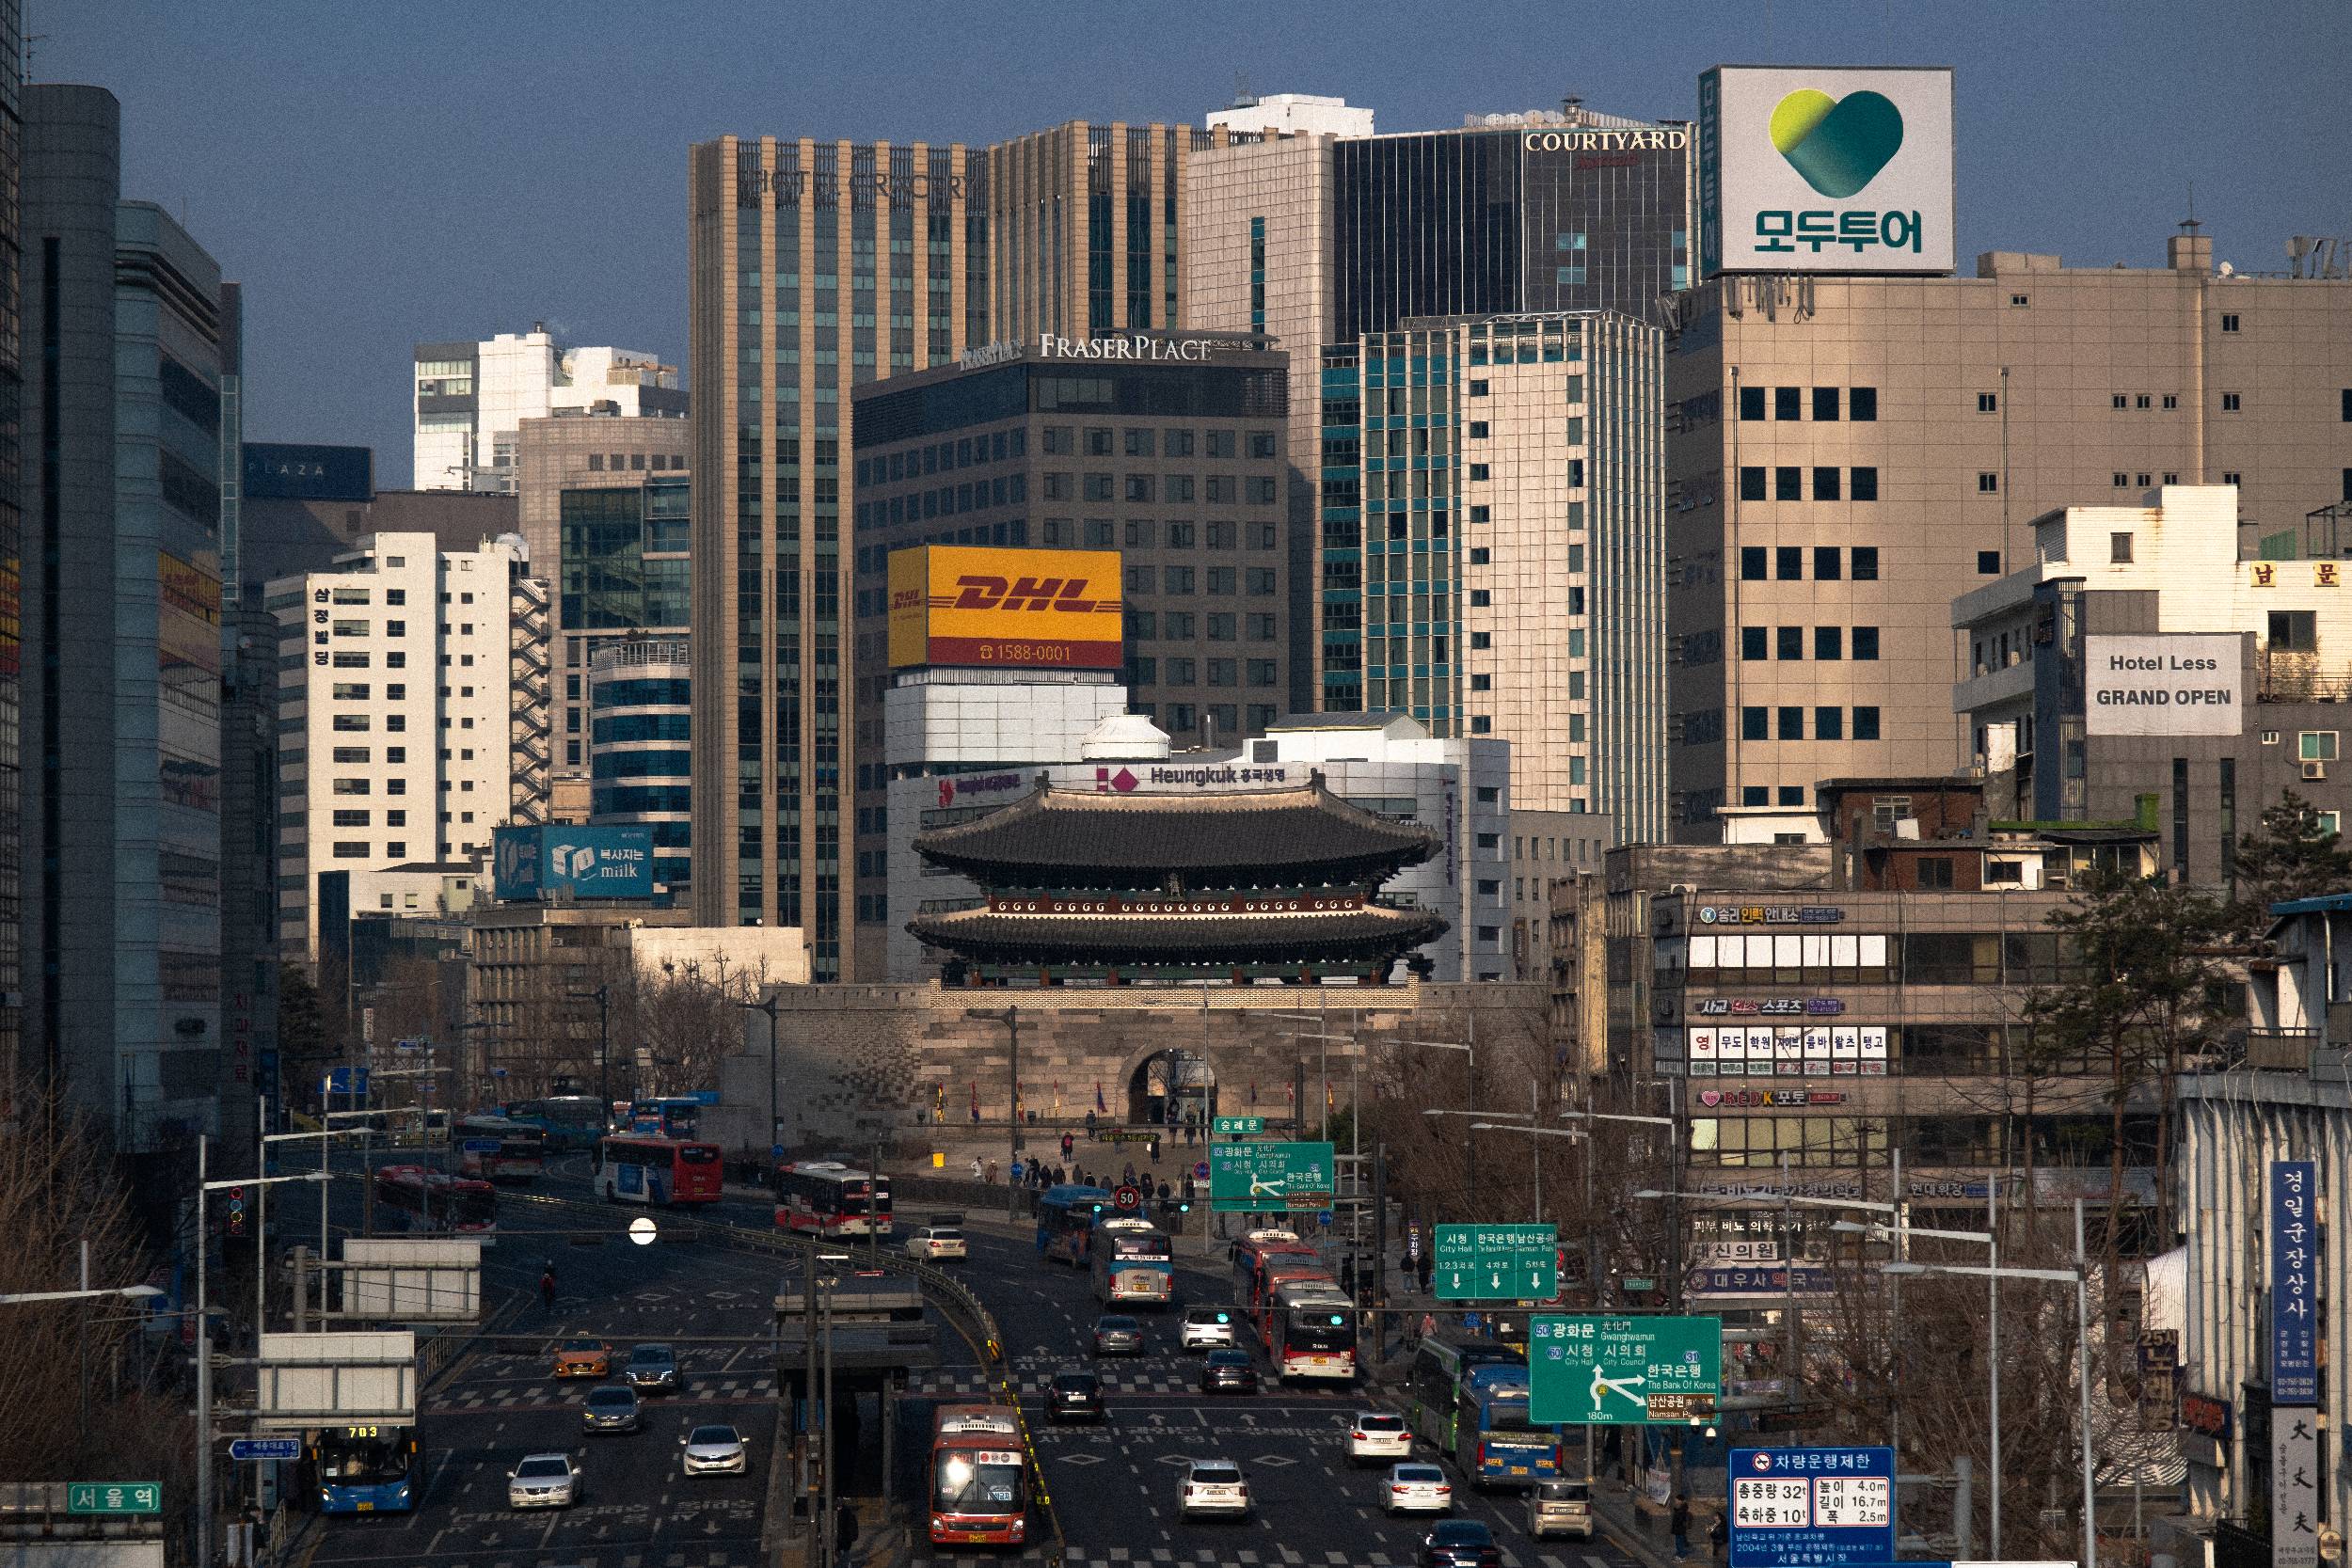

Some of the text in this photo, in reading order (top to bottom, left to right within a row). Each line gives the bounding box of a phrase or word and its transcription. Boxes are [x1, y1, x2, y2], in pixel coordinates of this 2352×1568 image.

[1525, 131, 1685, 151] COURTYARD
[1755, 211, 1921, 253] 모두투어
[248, 463, 324, 476] PLAZA
[893, 589, 920, 610] DHL
[954, 575, 1097, 612] DHL
[314, 587, 331, 666] 삼정빌딩
[997, 643, 1071, 661] 1588-0001
[2110, 655, 2217, 670] Hotel Less
[2096, 689, 2232, 705] GRAND OPEN
[1151, 767, 1284, 786] Heungkuk 흥국생명
[1701, 999, 1728, 1016] 사교
[1761, 999, 1803, 1015] 스포츠
[1696, 1036, 1709, 1051] 영
[1722, 1037, 1742, 1050] 무도
[1750, 1036, 1771, 1050] 학원
[1806, 1036, 1827, 1050] 룸바
[1835, 1036, 1855, 1050] 왈츠
[1863, 1036, 1883, 1050] 탱고
[1777, 1090, 1805, 1106] 포토
[1221, 1119, 1257, 1131] 숭례문
[1224, 1147, 1253, 1157] 광화문
[1286, 1172, 1322, 1182] 한국은행
[1120, 1193, 1134, 1205] 50
[1722, 1221, 1745, 1233] 비뇨
[1750, 1221, 1774, 1233] 의학
[1410, 1234, 1419, 1257] 주차장
[1446, 1233, 1555, 1244] 시청 한국은행 남산공원
[1439, 1245, 1455, 1254] City
[1457, 1244, 1472, 1253] Hall
[2283, 1170, 2309, 1322] 경일군장상사
[1714, 1273, 1806, 1287] 대우사약국
[1535, 1324, 1549, 1336] 50
[1552, 1321, 1631, 1338] 광화문 光化門
[1600, 1331, 1656, 1342] Gwanghwamun
[1549, 1347, 1562, 1358] 60
[1565, 1343, 1646, 1357] 시청 시의회
[1685, 1351, 1698, 1362] 31
[1565, 1357, 1645, 1367] City Hall City Council
[1647, 1364, 1701, 1378] 한국은행
[1647, 1380, 1717, 1390] The Bank Of Korea
[1648, 1395, 1684, 1408] 남산공원
[1587, 1411, 1613, 1420] 180m
[1648, 1410, 1679, 1418] Namsan
[348, 1426, 377, 1438] 703
[1775, 1453, 1870, 1469] 차량운행제한
[1739, 1482, 1777, 1499] 총중량
[1820, 1480, 1886, 1494] 높이 4.0m
[77, 1488, 152, 1509] 서울역
[1819, 1496, 1886, 1510] 길이 16.7m
[1739, 1506, 1777, 1523] 축하중
[1827, 1510, 1886, 1524] 폭 2.5m
[1736, 1543, 1769, 1552] 2004년
[1771, 1543, 1784, 1552] 3월
[1777, 1553, 1848, 1564] 서울특별시장
